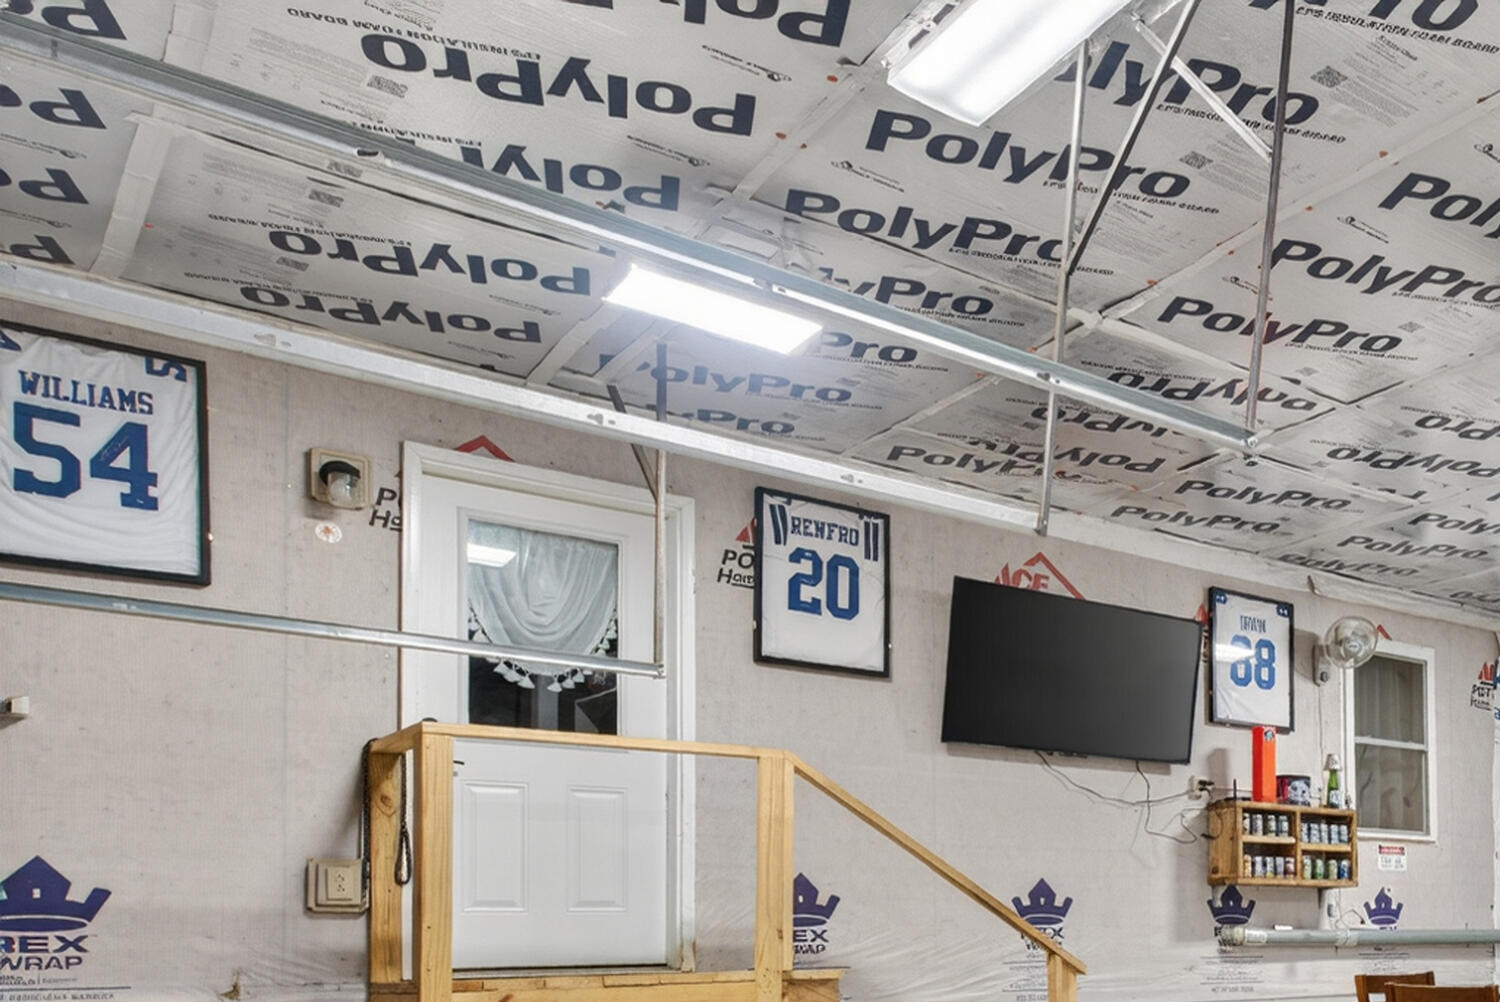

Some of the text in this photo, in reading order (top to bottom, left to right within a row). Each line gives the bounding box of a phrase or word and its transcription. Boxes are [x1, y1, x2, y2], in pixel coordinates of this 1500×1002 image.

[361, 32, 756, 136] PolyPro
[865, 109, 1191, 199] PolyPro
[268, 230, 591, 297] PolyPro
[240, 286, 542, 344] PolyPro
[18, 369, 154, 415] WILLIAMS
[13, 401, 159, 511] 54
[1111, 505, 1281, 533] PolyPro
[1175, 480, 1352, 510] PolyPro
[790, 515, 860, 546] RENFRO
[1336, 535, 1489, 559] PolyPro
[788, 547, 860, 620] 20
[793, 929, 830, 943] EX
